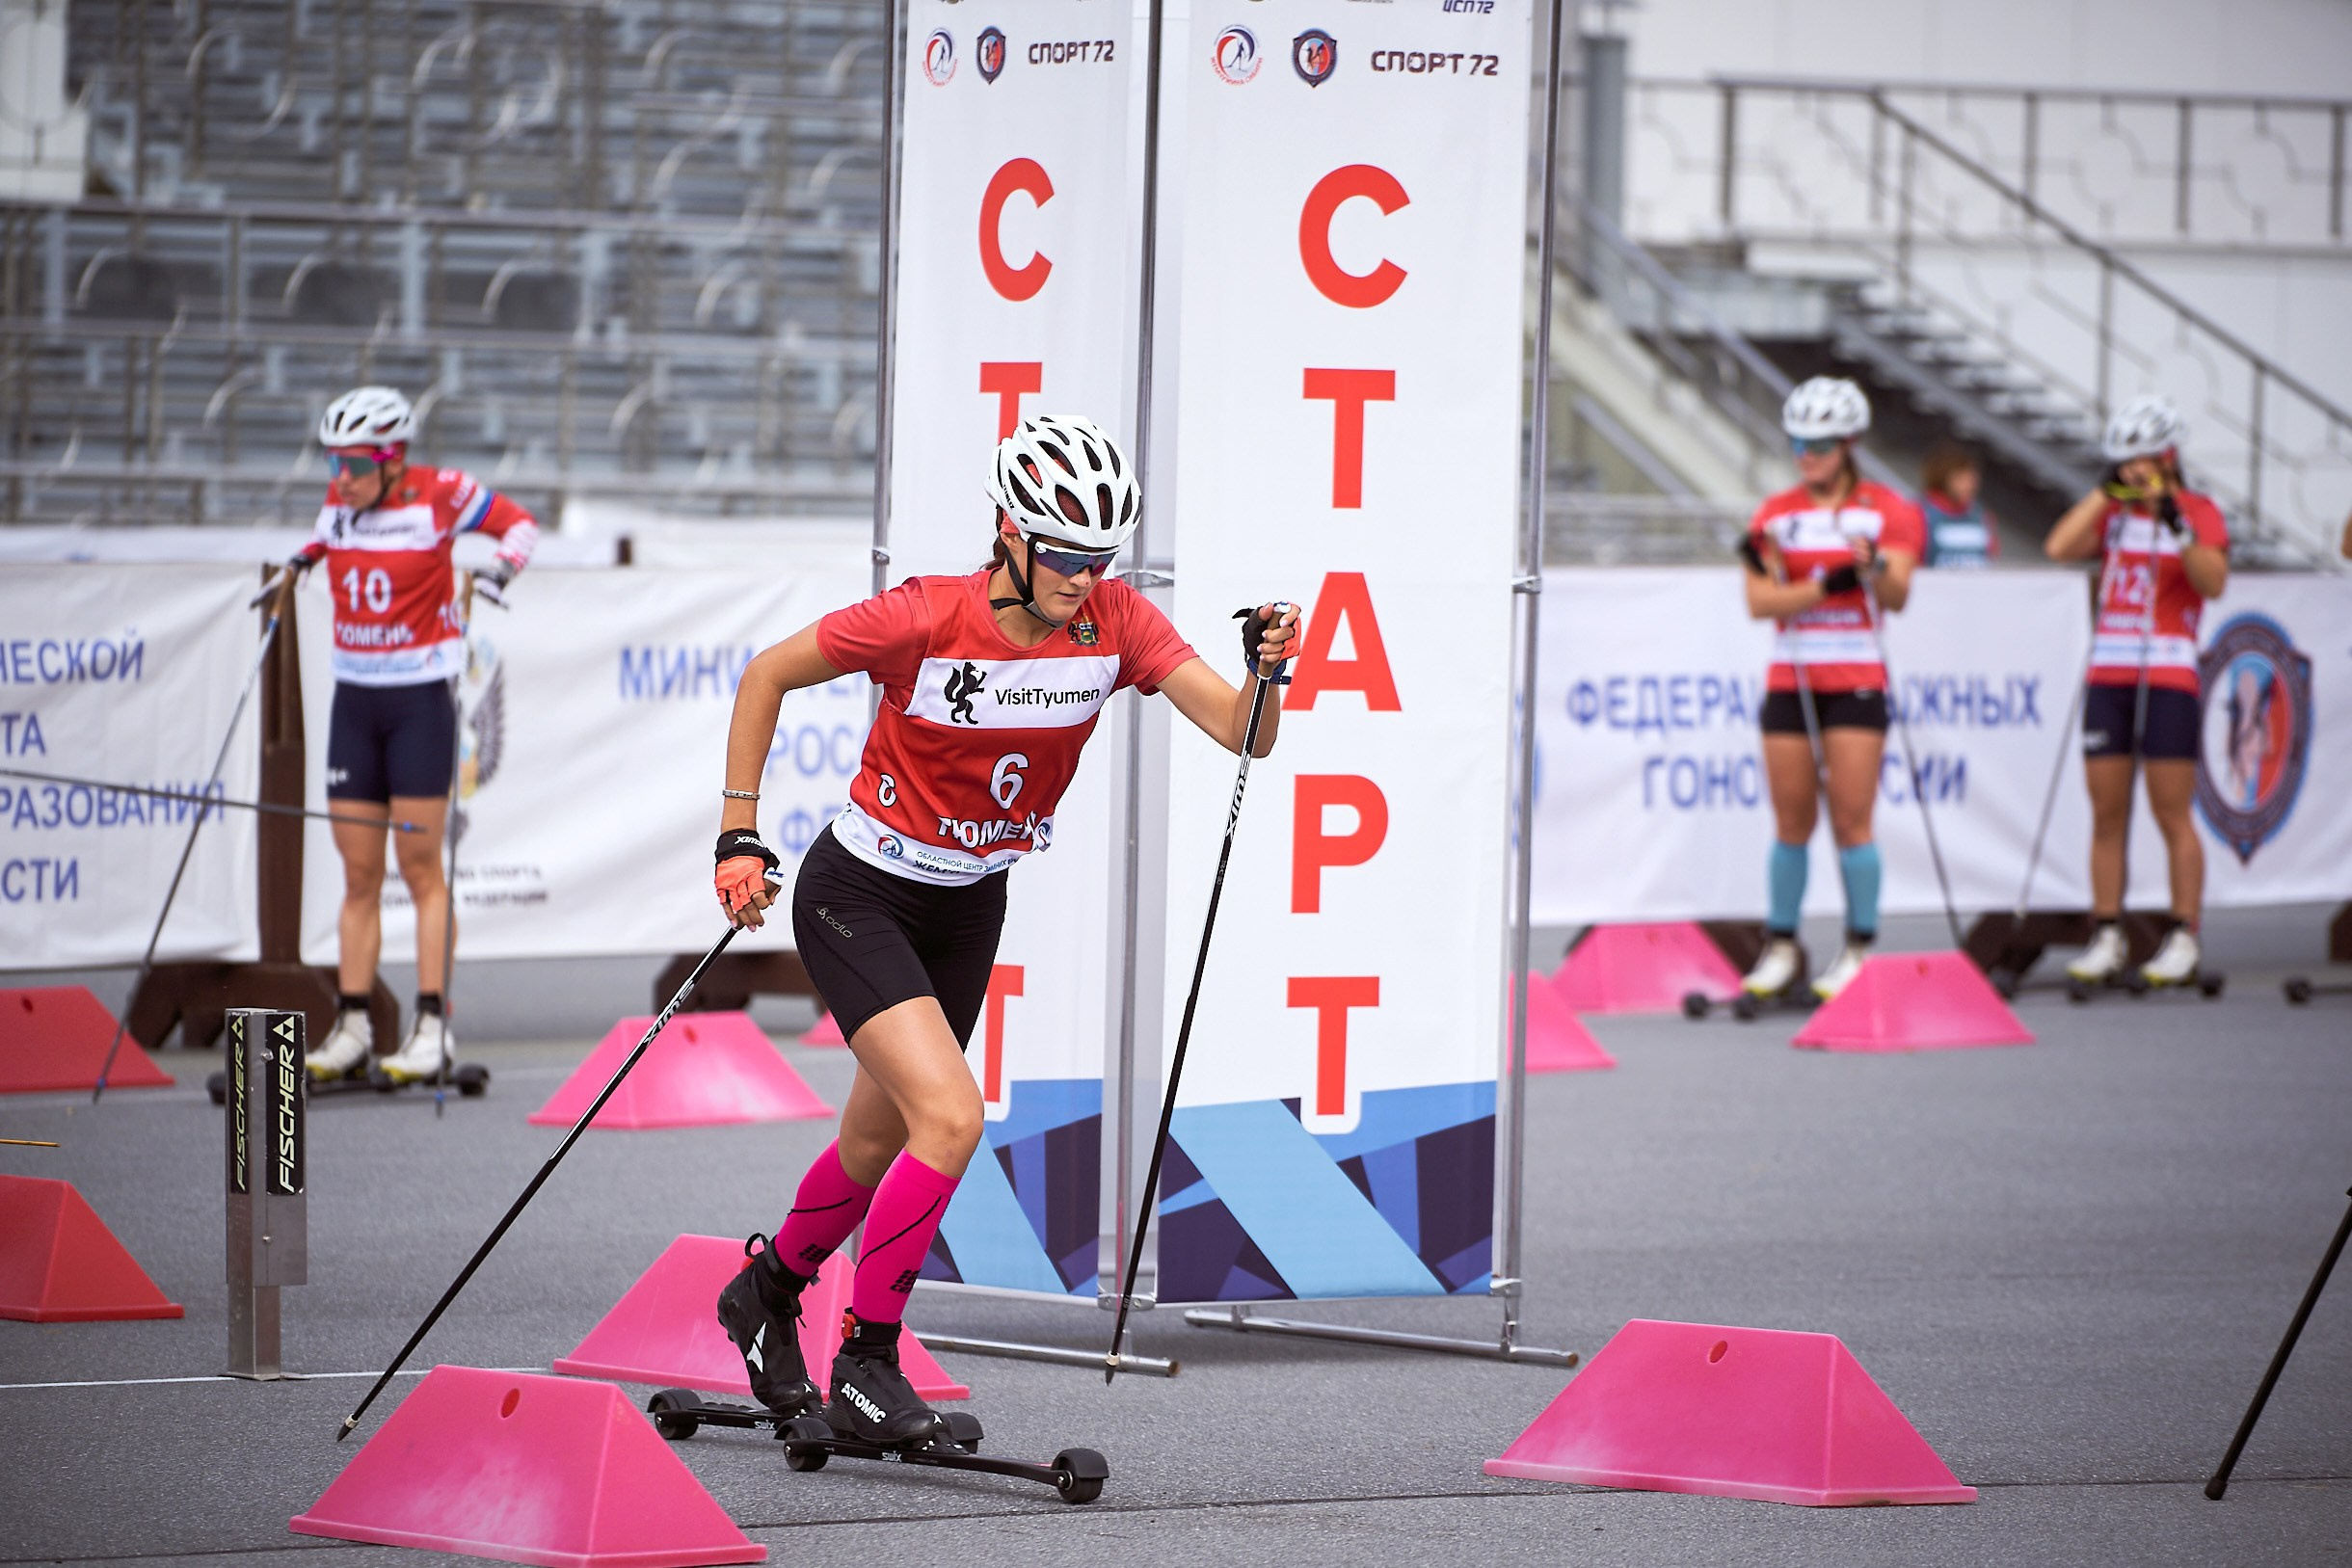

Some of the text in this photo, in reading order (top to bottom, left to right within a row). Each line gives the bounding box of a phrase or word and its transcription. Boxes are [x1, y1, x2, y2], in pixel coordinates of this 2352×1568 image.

[1029, 40, 1115, 65] СПОРТ 72
[1371, 50, 1499, 76] СПОРТ 72
[342, 567, 392, 614] 10
[1281, 164, 1410, 1115] СТАРТ
[995, 687, 1100, 708] VisitTyumen
[1566, 674, 1759, 735] ФЕДЕРА
[989, 753, 1029, 810] 6
[1643, 755, 1758, 809] ГОНО
[917, 851, 962, 868] ОБЛАСТНОЙ
[963, 862, 983, 871] ЦЕНТР
[825, 916, 853, 939] odlo
[234, 1043, 246, 1192] FISCHER
[279, 1044, 295, 1193] FISCHER
[841, 1382, 887, 1423] ATOMIC
